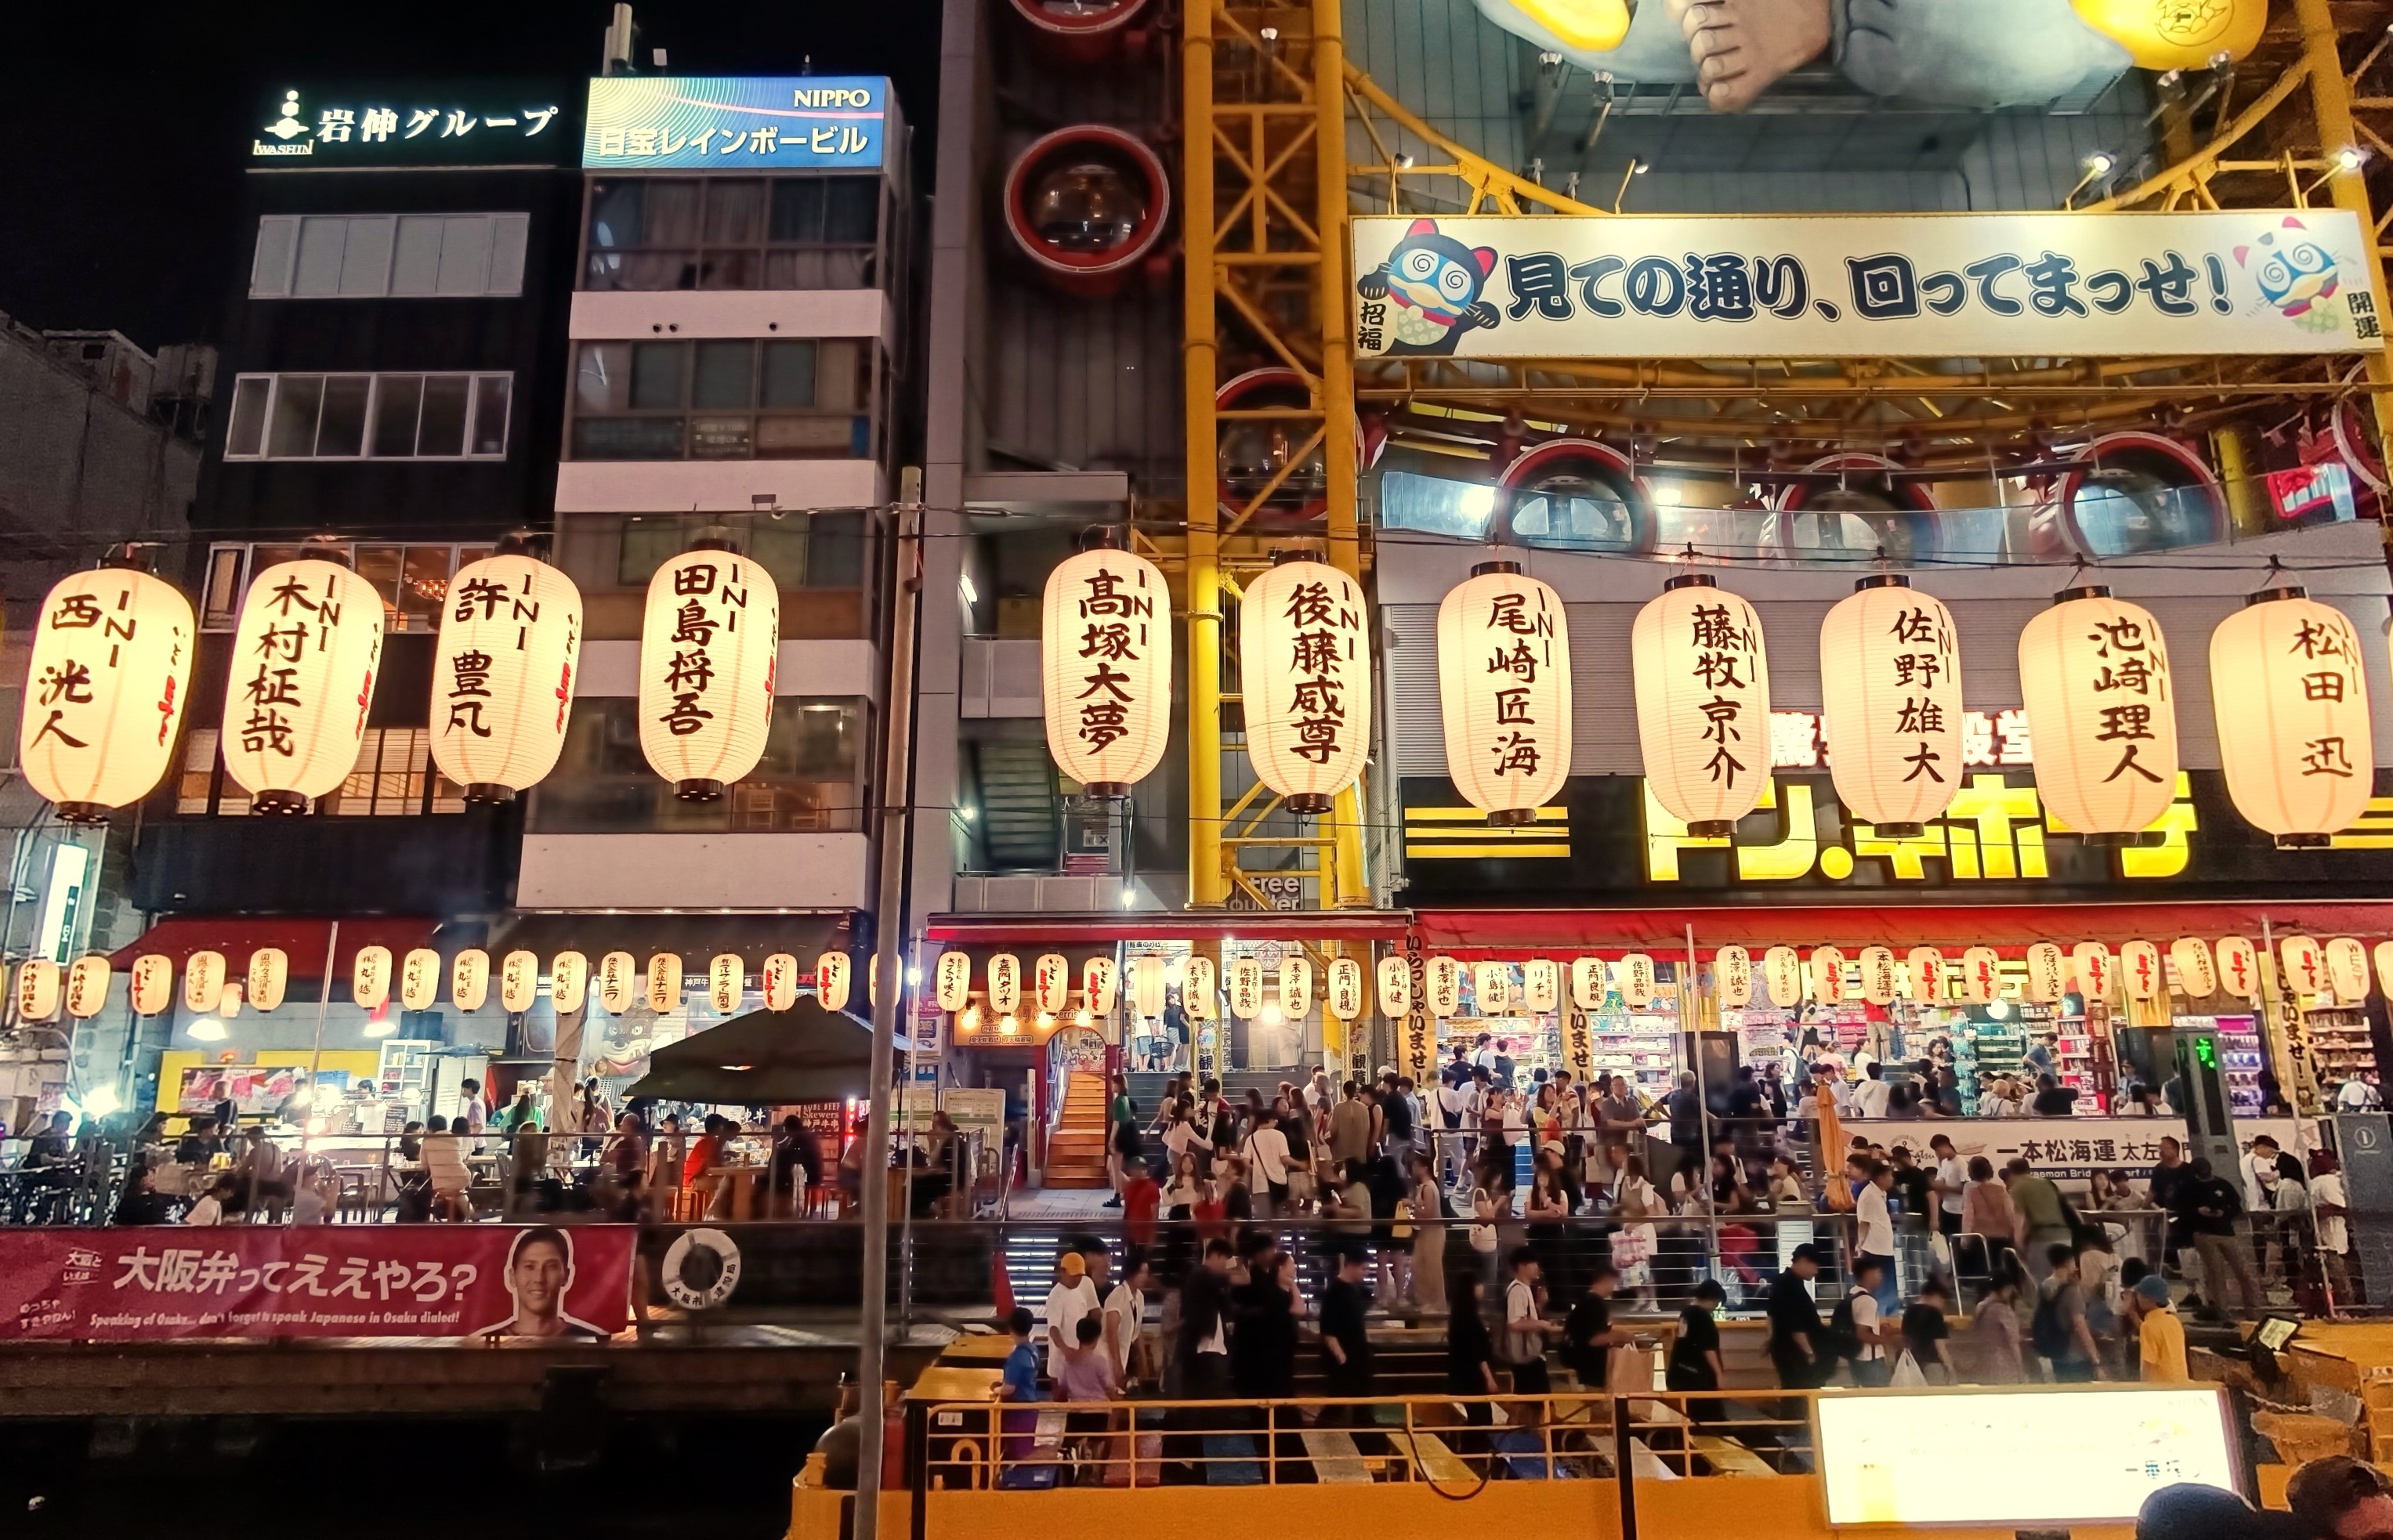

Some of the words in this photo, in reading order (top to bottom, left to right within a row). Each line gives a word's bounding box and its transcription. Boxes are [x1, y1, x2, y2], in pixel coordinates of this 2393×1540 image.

[317, 105, 559, 143] 岩伸グループ
[794, 89, 871, 108] NIPPO
[253, 139, 314, 156] IWASHIN
[599, 124, 868, 157] 日宝レインボービル
[1358, 302, 1386, 352] 招福
[2345, 290, 2381, 339] 開運
[104, 591, 136, 667] INI
[317, 575, 341, 652] INI
[513, 574, 540, 650] INI
[721, 563, 747, 632] INI
[1133, 569, 1153, 645] INI
[1340, 581, 1359, 660] INI
[1536, 587, 1554, 667] INI
[30, 594, 103, 750] 西洸人
[242, 575, 319, 757] 木村柾哉
[444, 578, 510, 738] 許豊凡
[660, 564, 720, 736] 田島将吾
[1283, 581, 1345, 765] 後藤威尊
[1740, 603, 1758, 682] INI
[1933, 603, 1953, 683] INI
[2146, 619, 2167, 702] INI
[2334, 613, 2359, 695] INI
[1486, 593, 1541, 777] 尾崎匠海
[1691, 603, 1747, 790] 藤牧京介
[1887, 606, 1946, 783] 佐野雄大
[2288, 618, 2354, 778] 松田迅
[1225, 894, 1300, 910] outer
[604, 956, 620, 1001] 株式会社ナニワ
[654, 957, 668, 1005] 株式会社ナニワ
[997, 957, 1012, 1007] 嘉門タツオ
[803, 1110, 839, 1119] Skewers
[1997, 1140, 2117, 1162] 一本松海運
[113, 1245, 478, 1303] 大阪弁ってええやろ?
[90, 1313, 141, 1329] Speaking
[228, 1311, 259, 1325] forget
[271, 1310, 308, 1325] speak
[310, 1310, 366, 1326] Japanese
[369, 1310, 380, 1324] in
[383, 1311, 418, 1324] Osaka
[420, 1310, 460, 1324] dialect!
